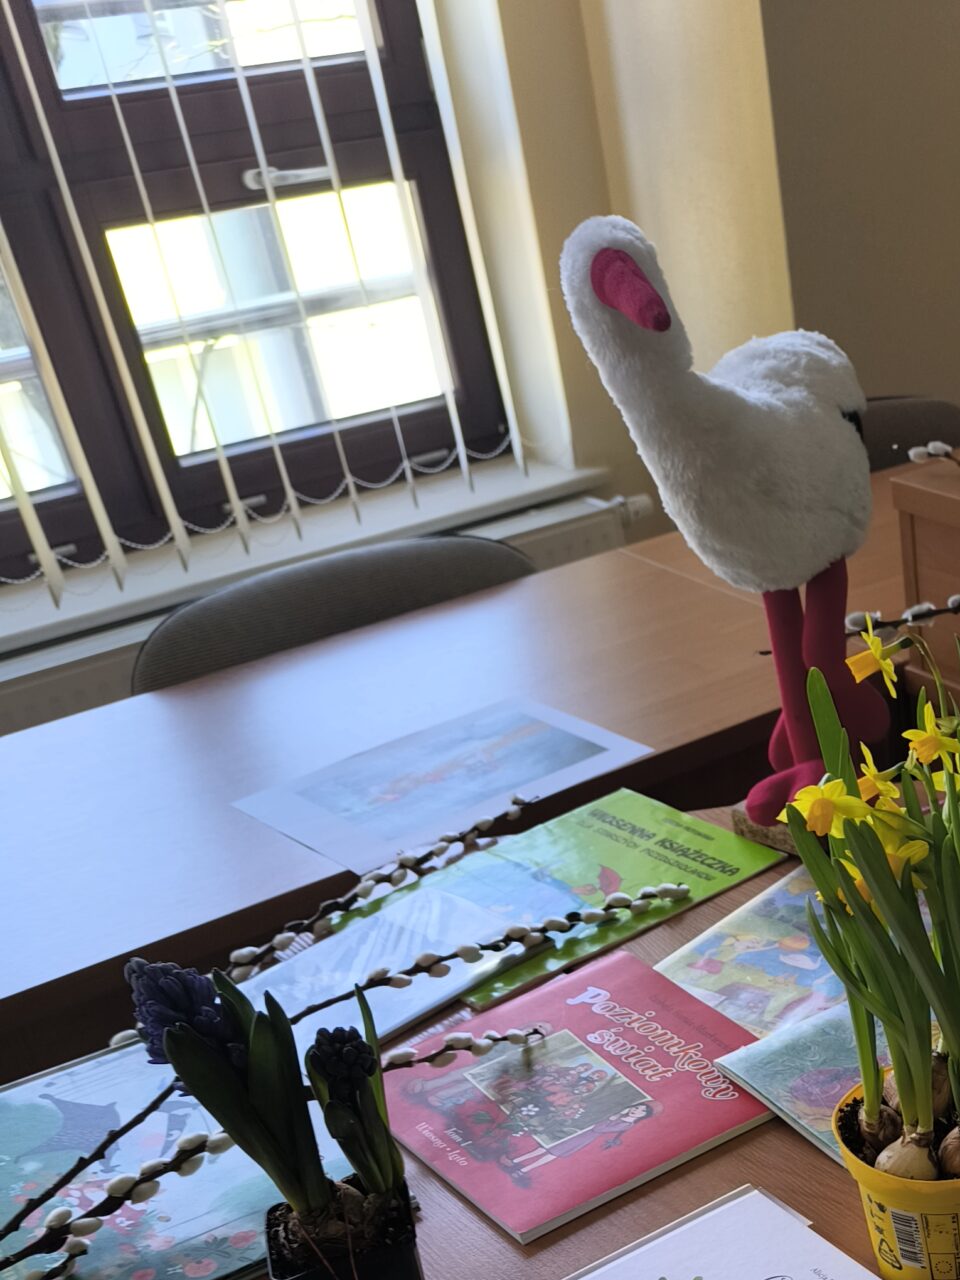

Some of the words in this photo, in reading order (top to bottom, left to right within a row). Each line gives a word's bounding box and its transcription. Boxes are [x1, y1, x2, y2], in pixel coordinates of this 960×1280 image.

[654, 836, 741, 877] KSIĄŻECZKA
[566, 986, 738, 1101] Poziomkowy
[587, 1027, 676, 1083] świat
